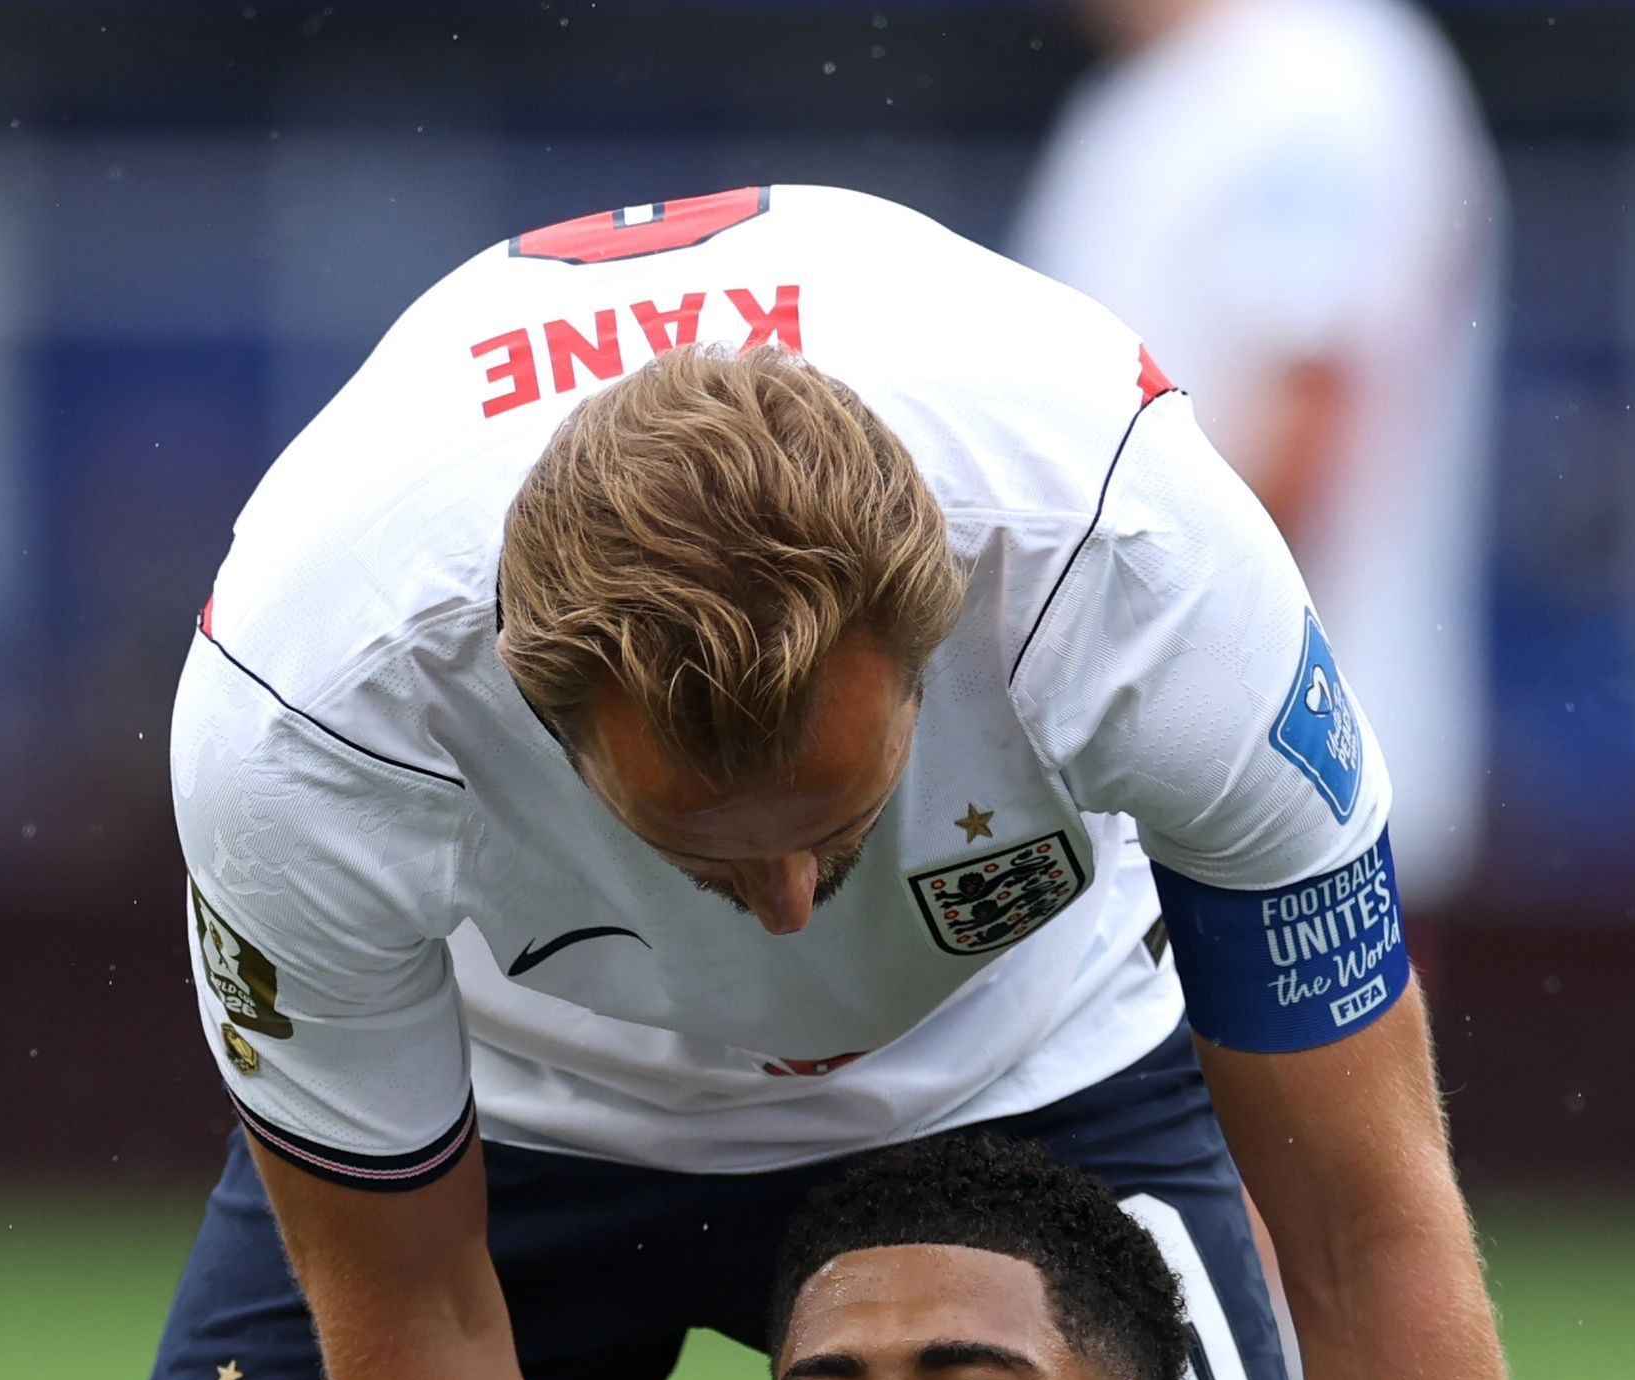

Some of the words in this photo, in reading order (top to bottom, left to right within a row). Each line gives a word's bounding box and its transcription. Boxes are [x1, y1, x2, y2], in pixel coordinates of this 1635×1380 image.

[469, 284, 803, 419] KANE
[1261, 842, 1384, 927] FOOTBALL
[1265, 870, 1391, 968] UNITES
[1267, 967, 1332, 1008] the
[1332, 903, 1402, 989] World
[1334, 980, 1386, 1022] FIFA
